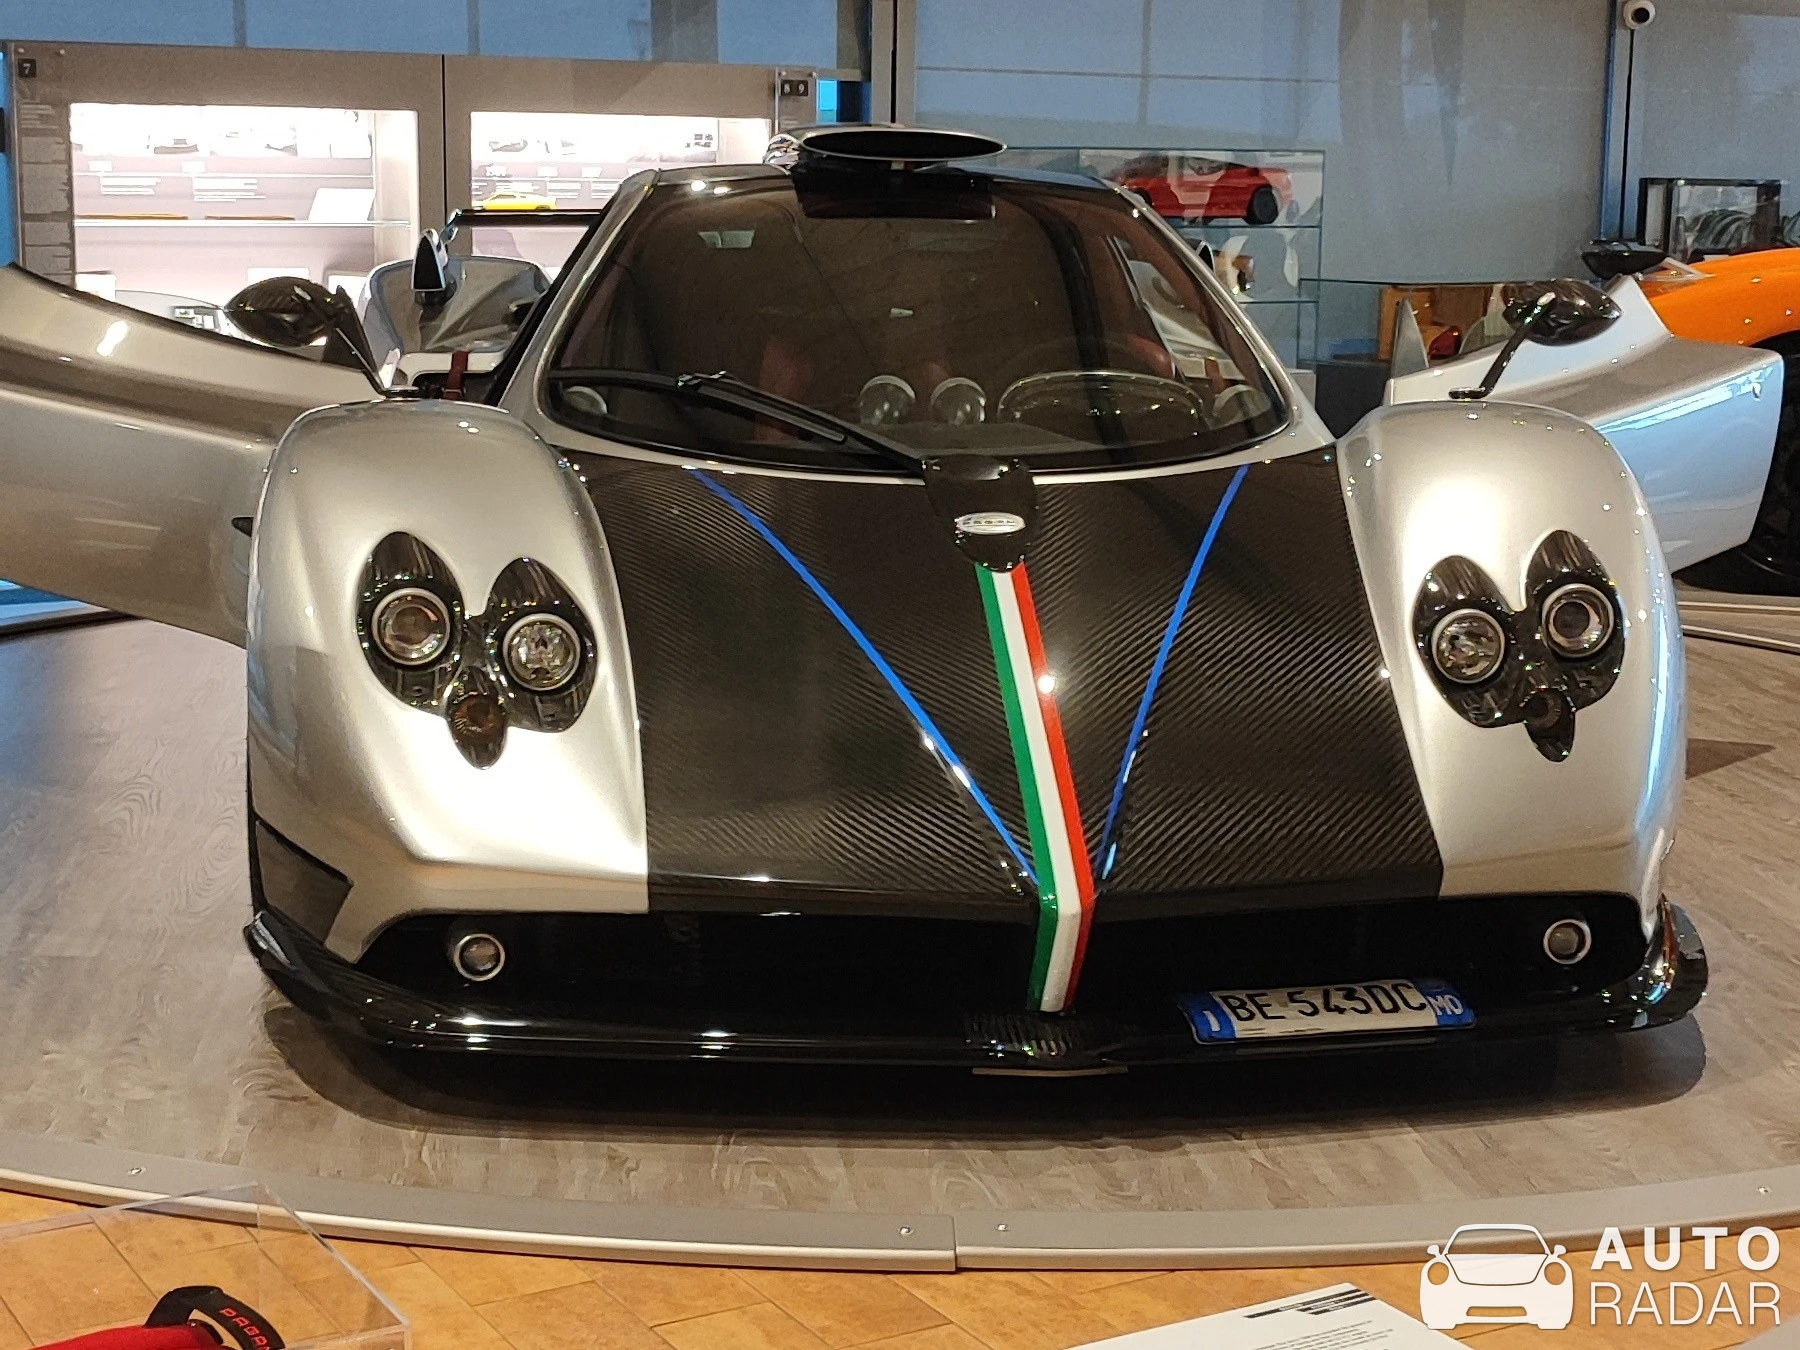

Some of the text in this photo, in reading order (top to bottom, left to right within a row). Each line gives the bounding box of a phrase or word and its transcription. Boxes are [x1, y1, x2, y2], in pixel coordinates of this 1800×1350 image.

[22, 63, 31, 75] 7
[1217, 994, 1286, 1022] BE
[1427, 994, 1464, 1016] MO
